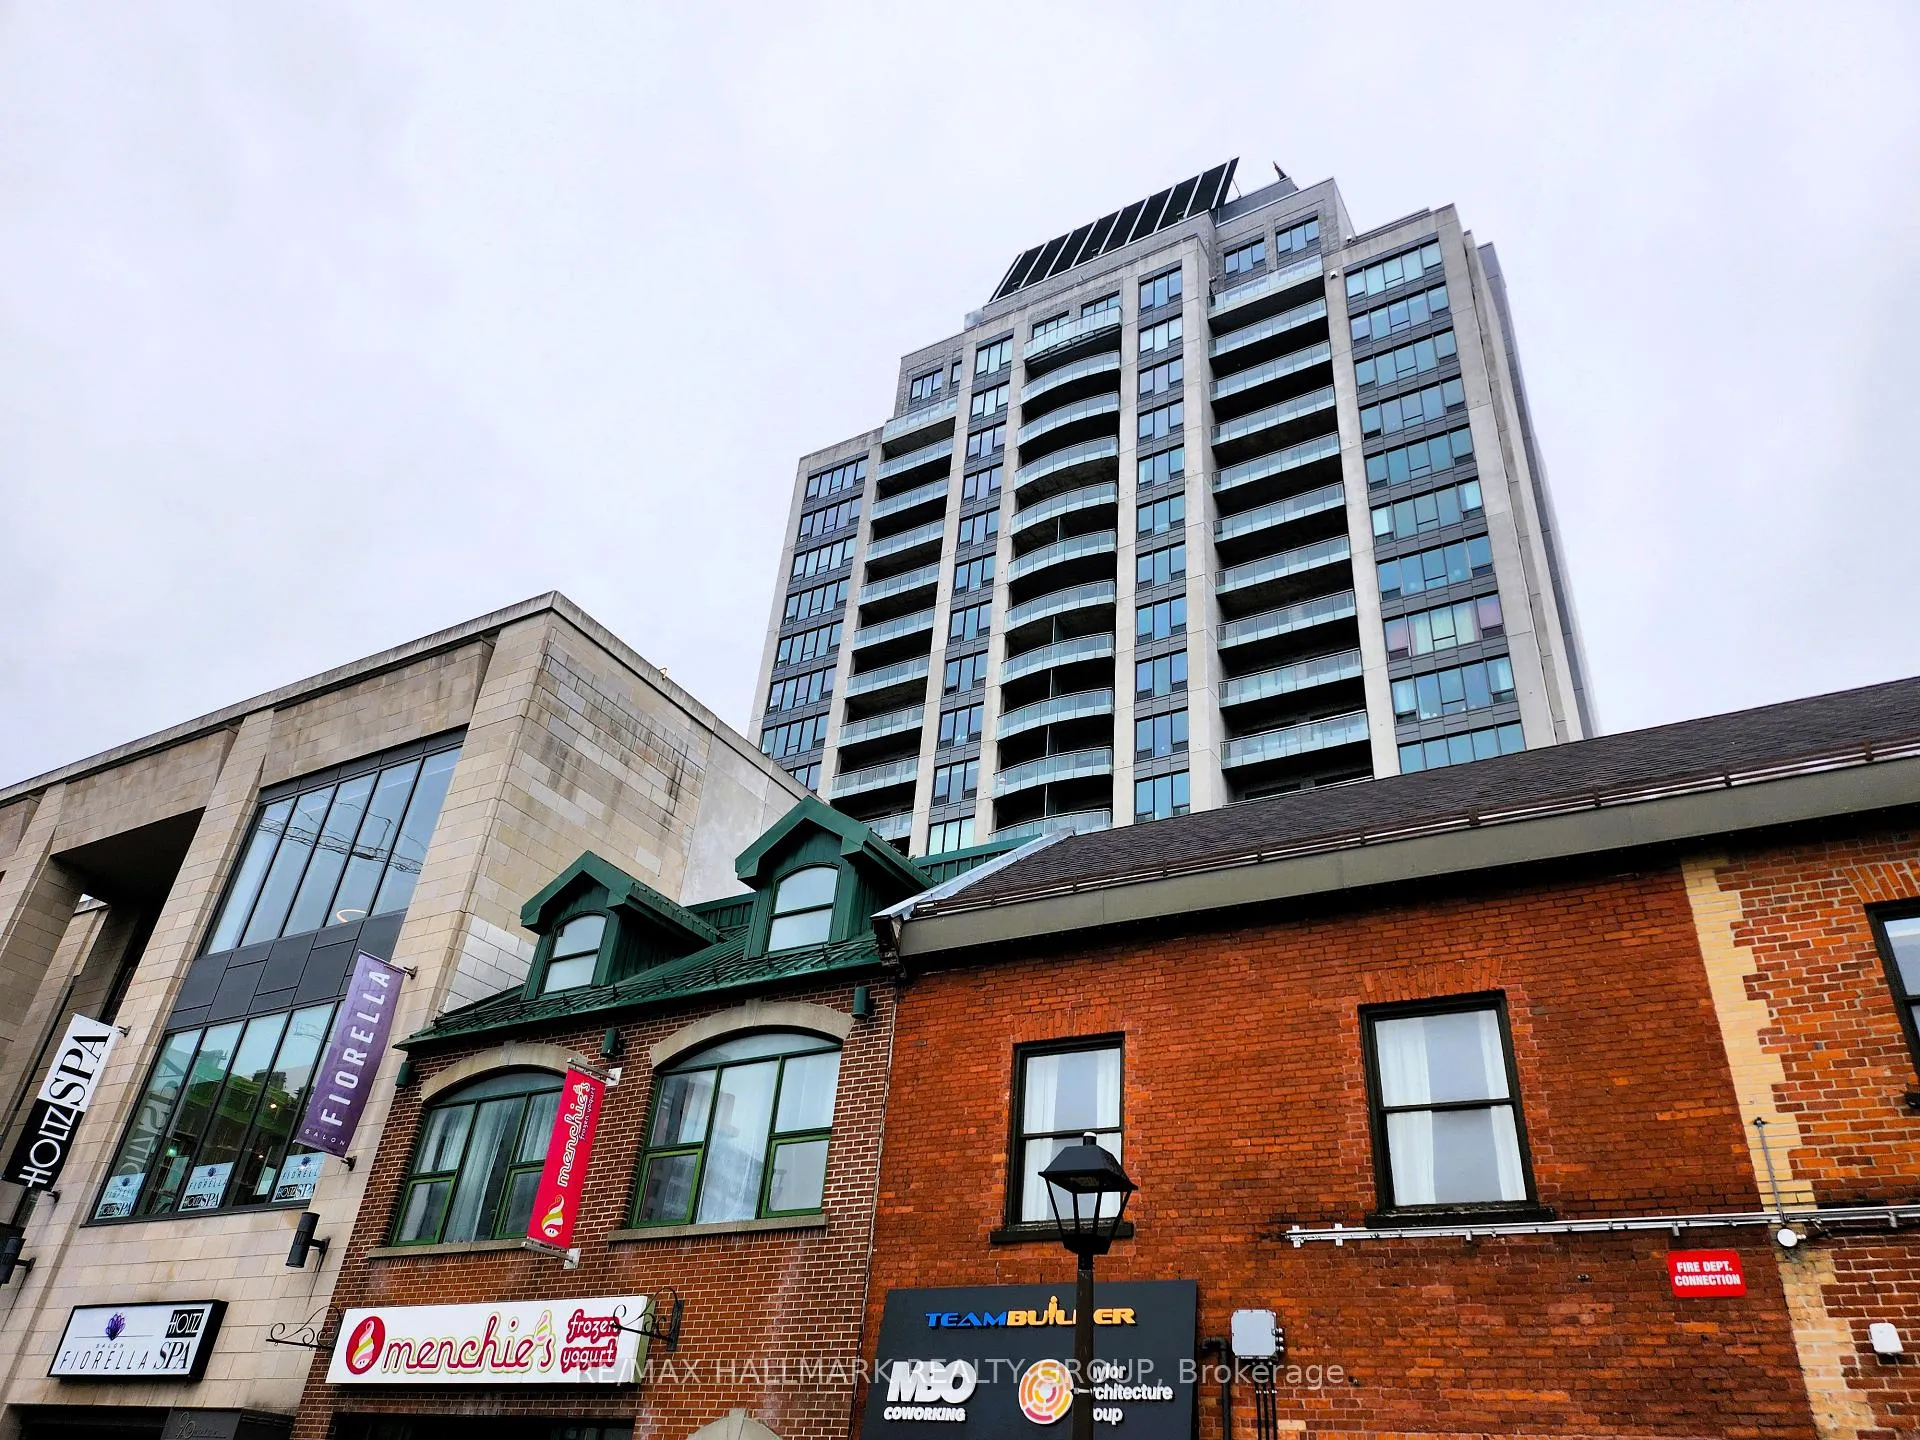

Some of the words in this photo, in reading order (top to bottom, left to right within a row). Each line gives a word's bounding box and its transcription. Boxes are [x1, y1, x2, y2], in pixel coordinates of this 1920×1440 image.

[321, 970, 391, 1127] FIORELLA
[18, 1104, 77, 1187] HOLTZ
[49, 1032, 111, 1106] SPA
[304, 1128, 346, 1146] SALON
[557, 1082, 590, 1187] menchie's
[1674, 1274, 1741, 1287] CONNECTION
[1676, 1261, 1701, 1273] FIRE
[1702, 1260, 1733, 1272] DEPT.
[168, 1312, 203, 1334] HOLTZ
[925, 1296, 1136, 1328] TEAMBUILER
[153, 1341, 191, 1370] SPA
[382, 1310, 556, 1374] menchie's
[561, 1339, 617, 1372] yogurt
[59, 1350, 150, 1370] FIORELLA
[886, 1359, 977, 1404] MBO
[1092, 1384, 1174, 1401] rchitecture
[883, 1406, 967, 1422] COWORKING
